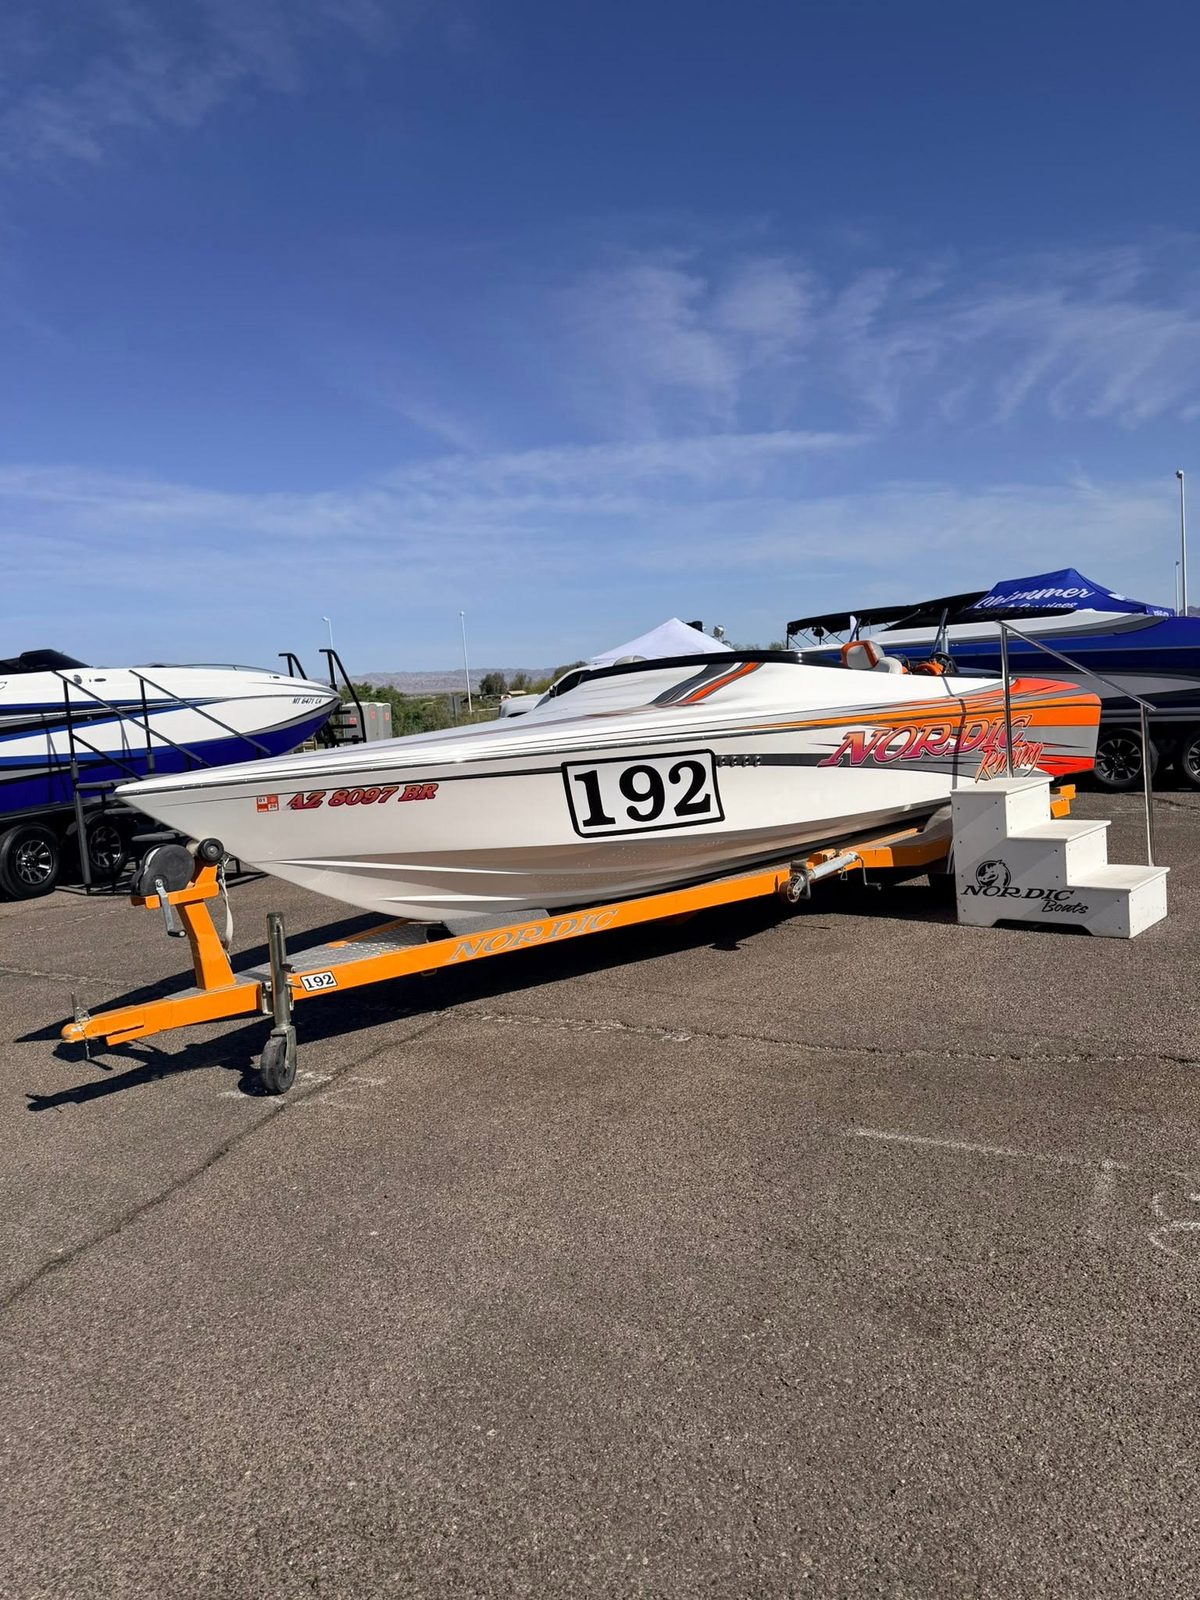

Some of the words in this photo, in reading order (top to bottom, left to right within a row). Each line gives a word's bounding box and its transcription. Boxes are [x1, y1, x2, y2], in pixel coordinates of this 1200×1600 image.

[817, 714, 1032, 768] NORDIC
[286, 791, 327, 810] AZ
[328, 786, 398, 807] 8097
[398, 783, 439, 802] BR
[574, 760, 711, 827] 192
[961, 885, 1075, 901] NORDIC
[1041, 900, 1089, 914] Boats
[449, 909, 619, 962] NORDIC
[304, 975, 334, 990] 192
